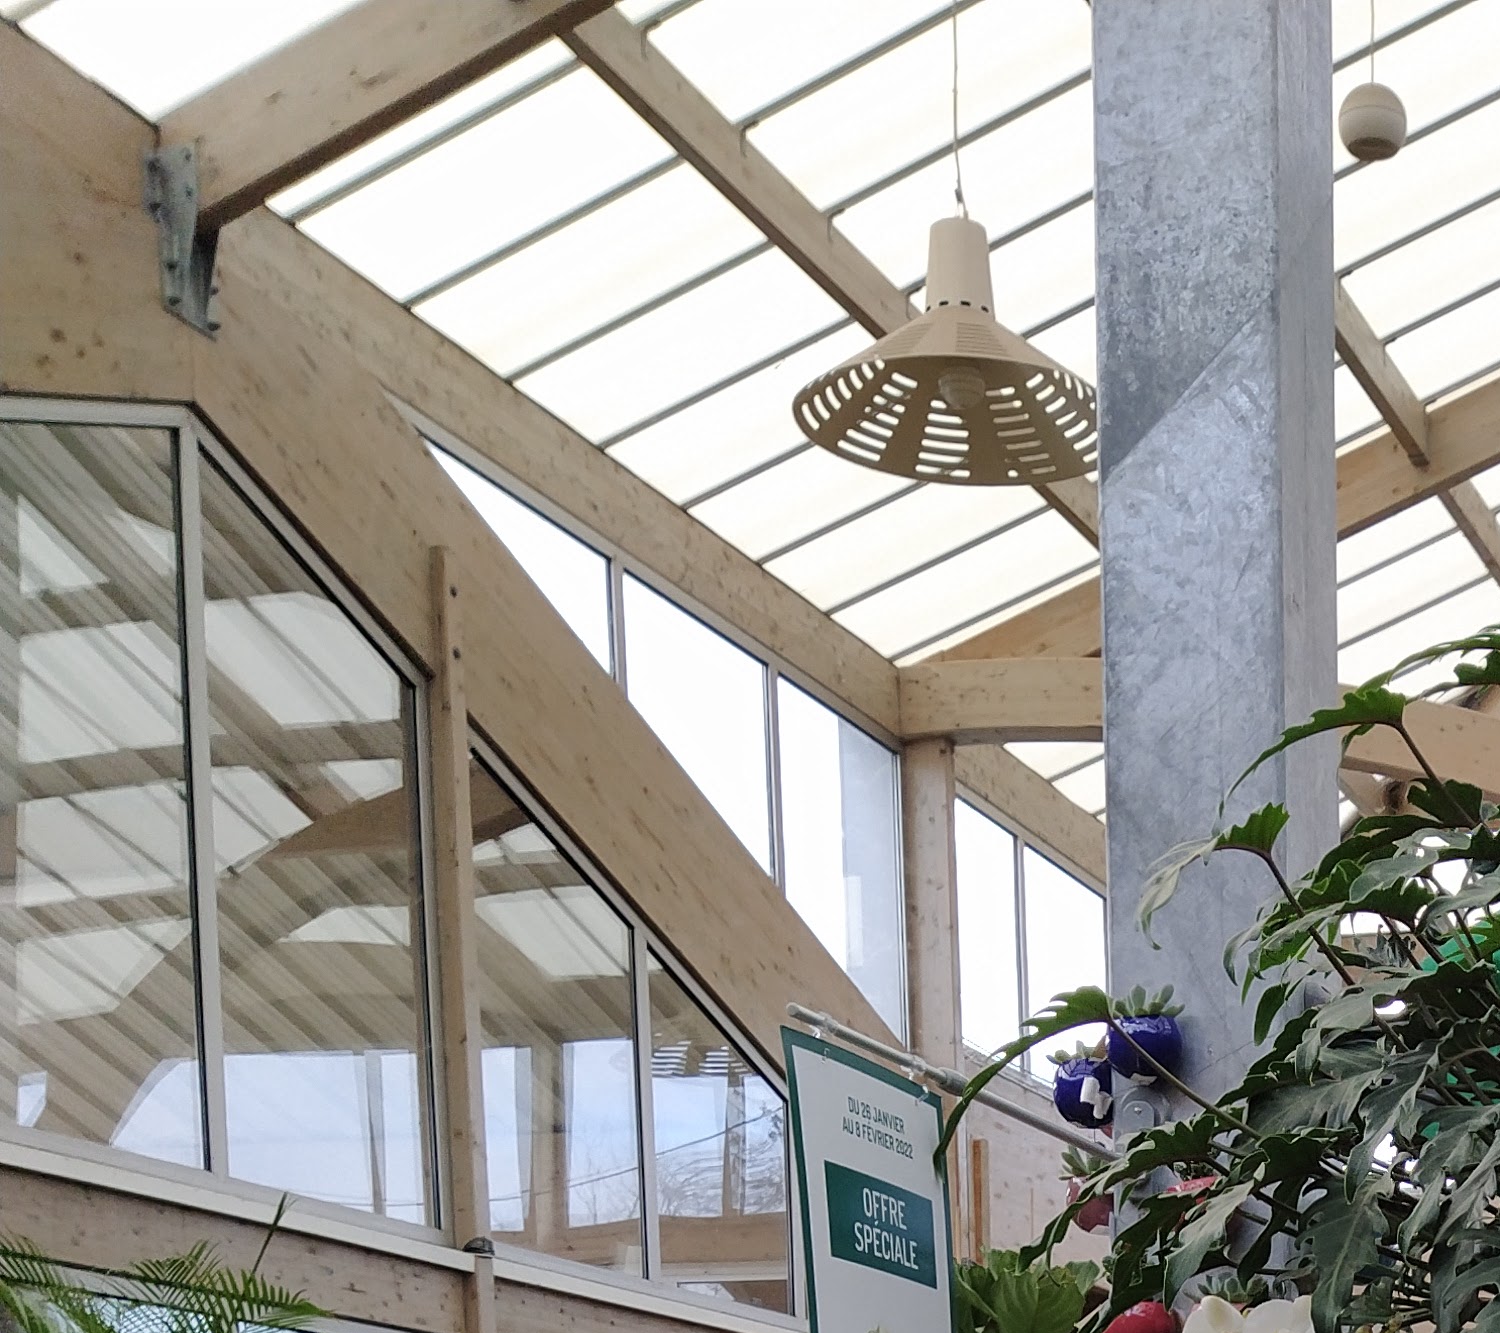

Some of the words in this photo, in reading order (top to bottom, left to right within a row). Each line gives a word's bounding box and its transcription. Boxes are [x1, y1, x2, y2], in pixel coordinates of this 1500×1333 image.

[848, 1096, 859, 1115] DU
[873, 1107, 904, 1134] JANVIER
[843, 1116, 853, 1134] AU
[855, 1121, 860, 1137] 8
[862, 1121, 894, 1151] FÉVRIER
[896, 1138, 914, 1159] 2022
[863, 1187, 908, 1230] OFFRE
[854, 1220, 919, 1270] SPÉCIALE
